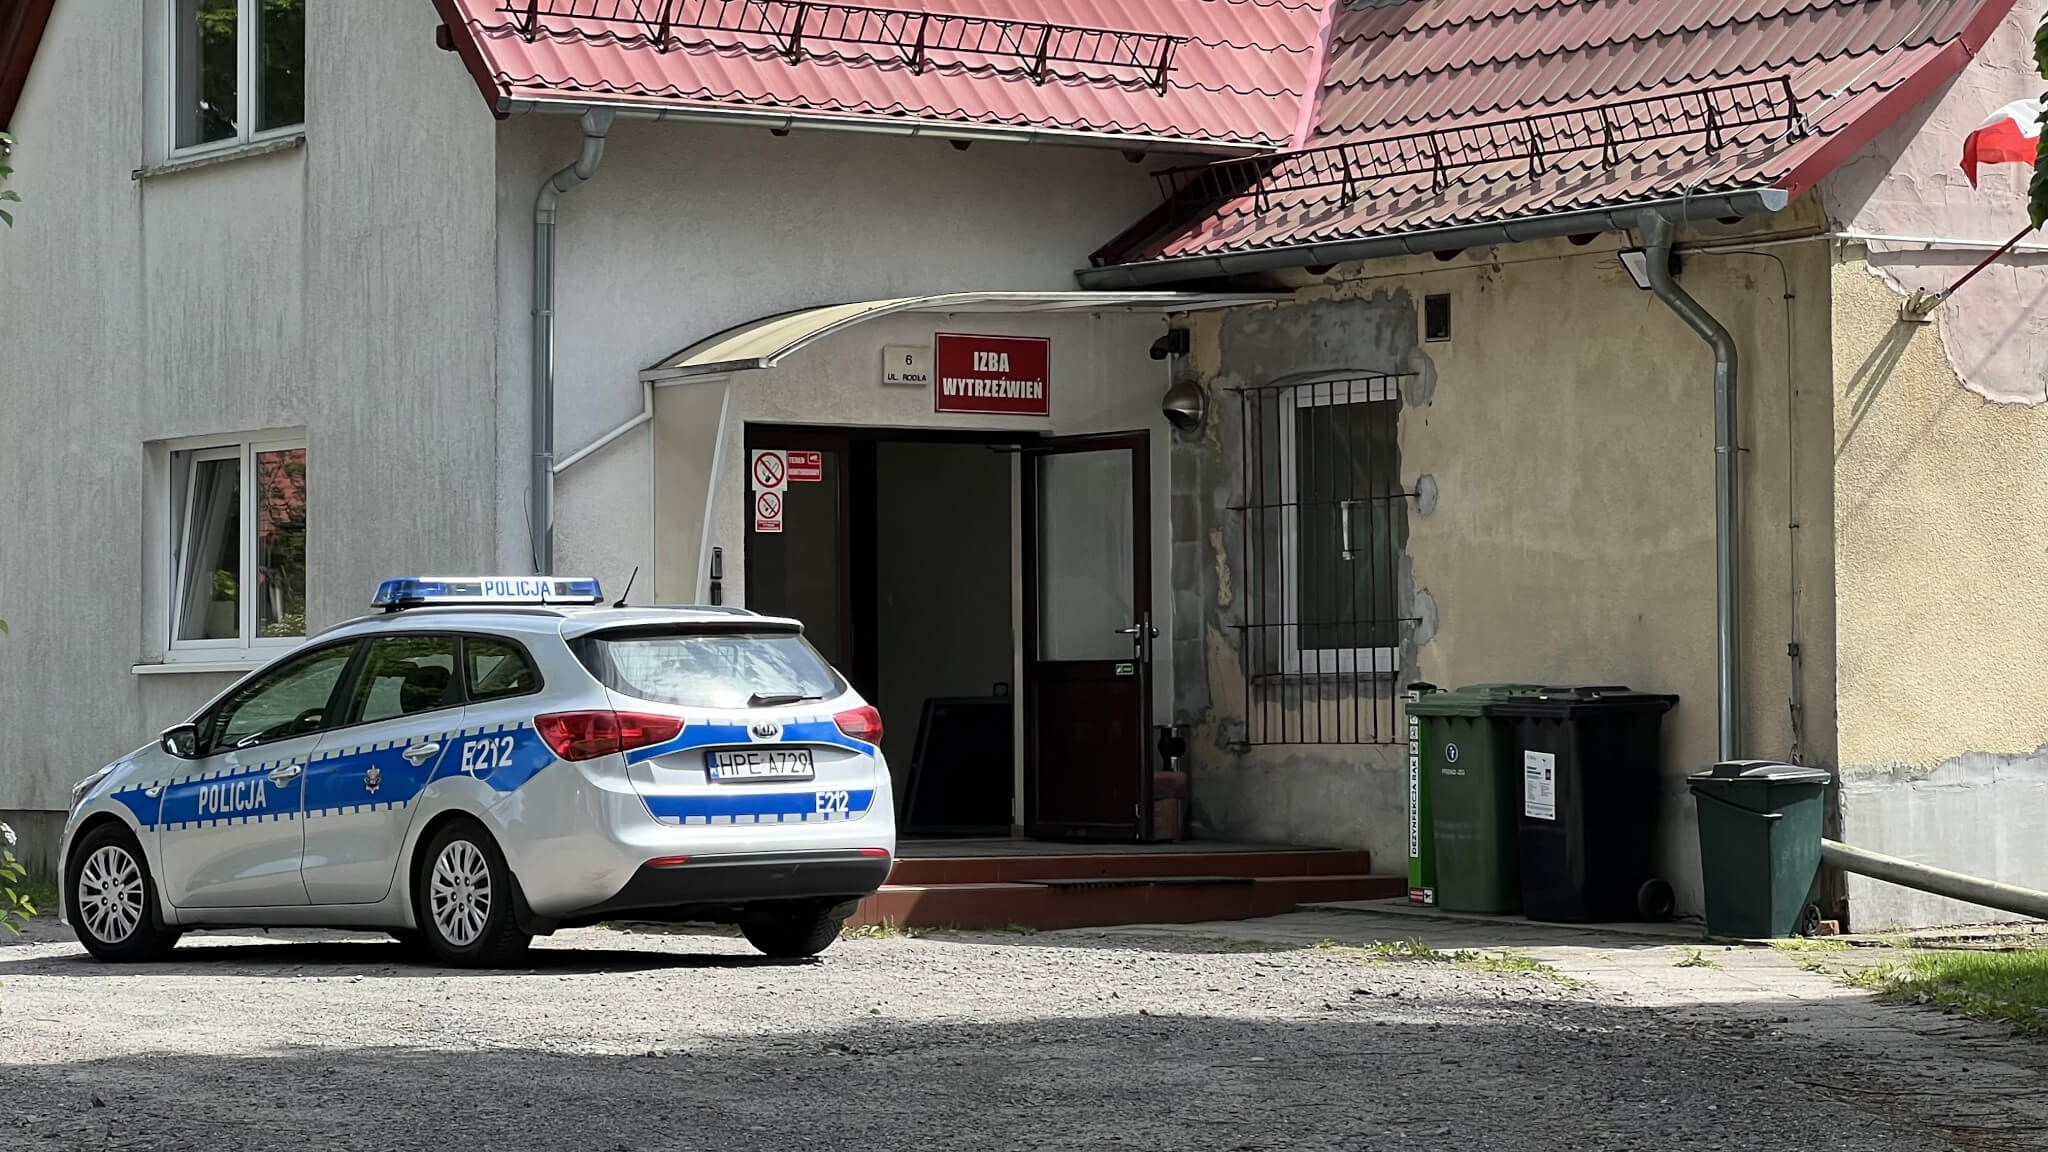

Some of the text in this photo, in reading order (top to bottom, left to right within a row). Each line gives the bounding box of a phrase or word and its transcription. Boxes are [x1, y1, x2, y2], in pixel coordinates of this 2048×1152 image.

[905, 354, 913, 366] 6
[973, 351, 1010, 373] IZBA
[942, 376, 1043, 399] WYTRZEŹWIEŃ
[485, 580, 552, 597] POLICJA
[461, 735, 515, 772] E212
[719, 752, 808, 776] HPE A729
[198, 778, 267, 816] POLICJA
[815, 790, 849, 814] E212
